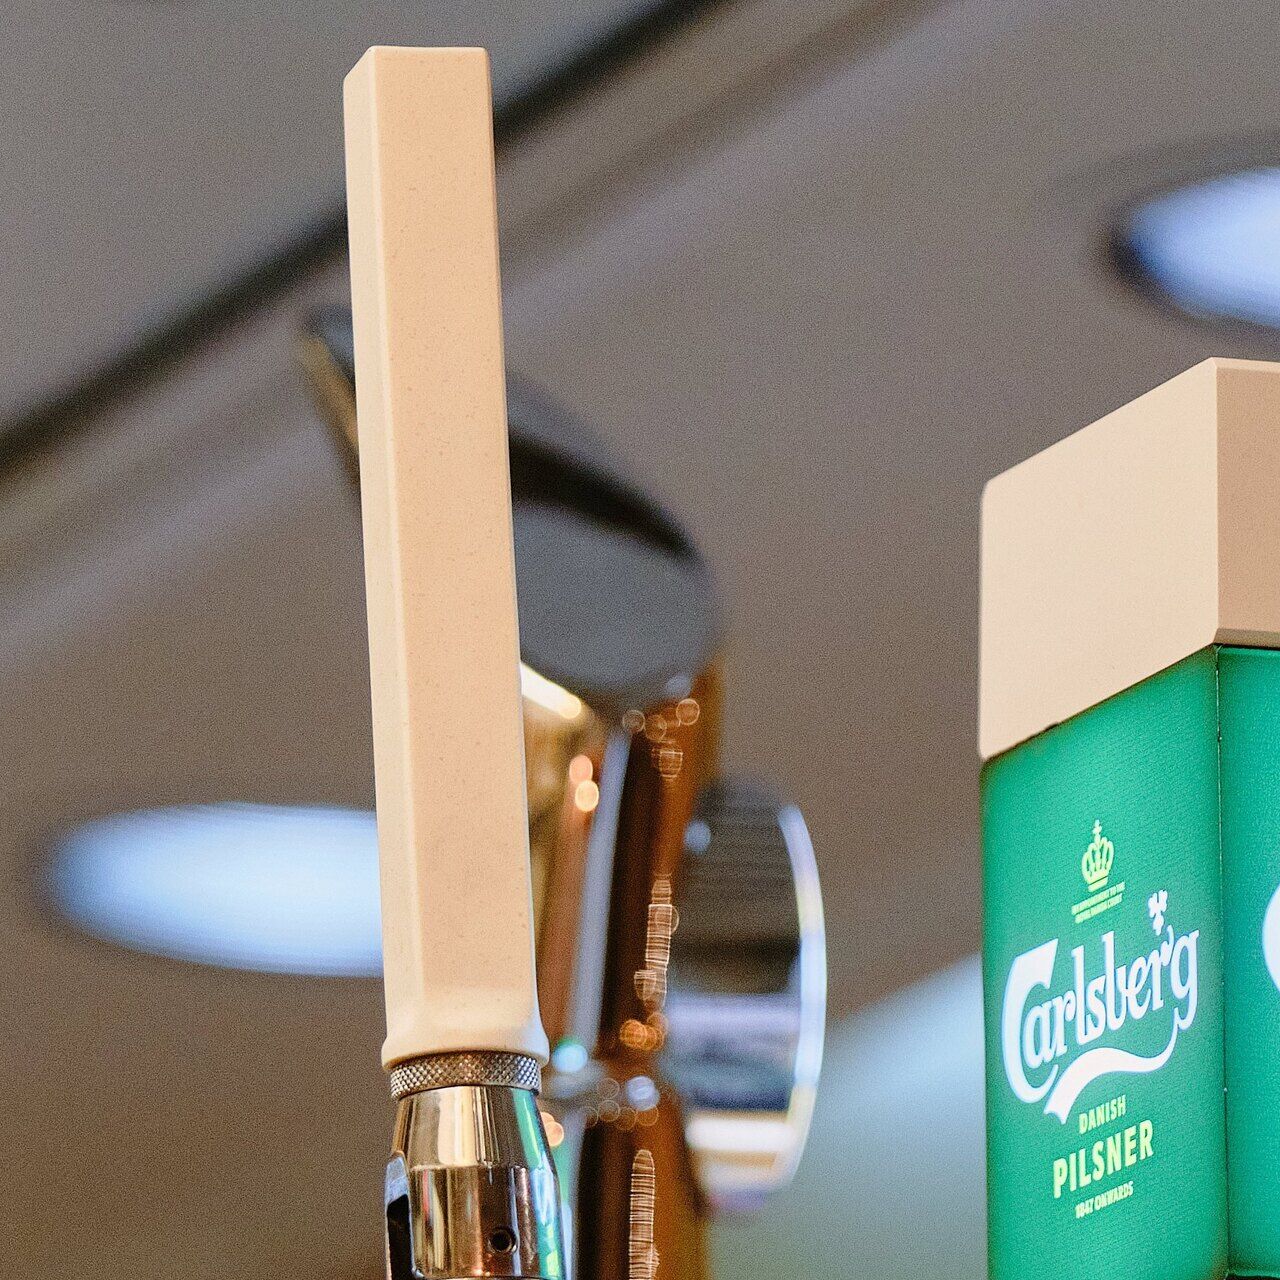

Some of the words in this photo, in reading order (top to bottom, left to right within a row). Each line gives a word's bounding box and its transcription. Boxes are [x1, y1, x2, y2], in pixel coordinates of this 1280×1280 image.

[1001, 922, 1200, 1124] Carlsberg
[1078, 1094, 1127, 1135] DANISH
[1052, 1119, 1154, 1199] PILSNER
